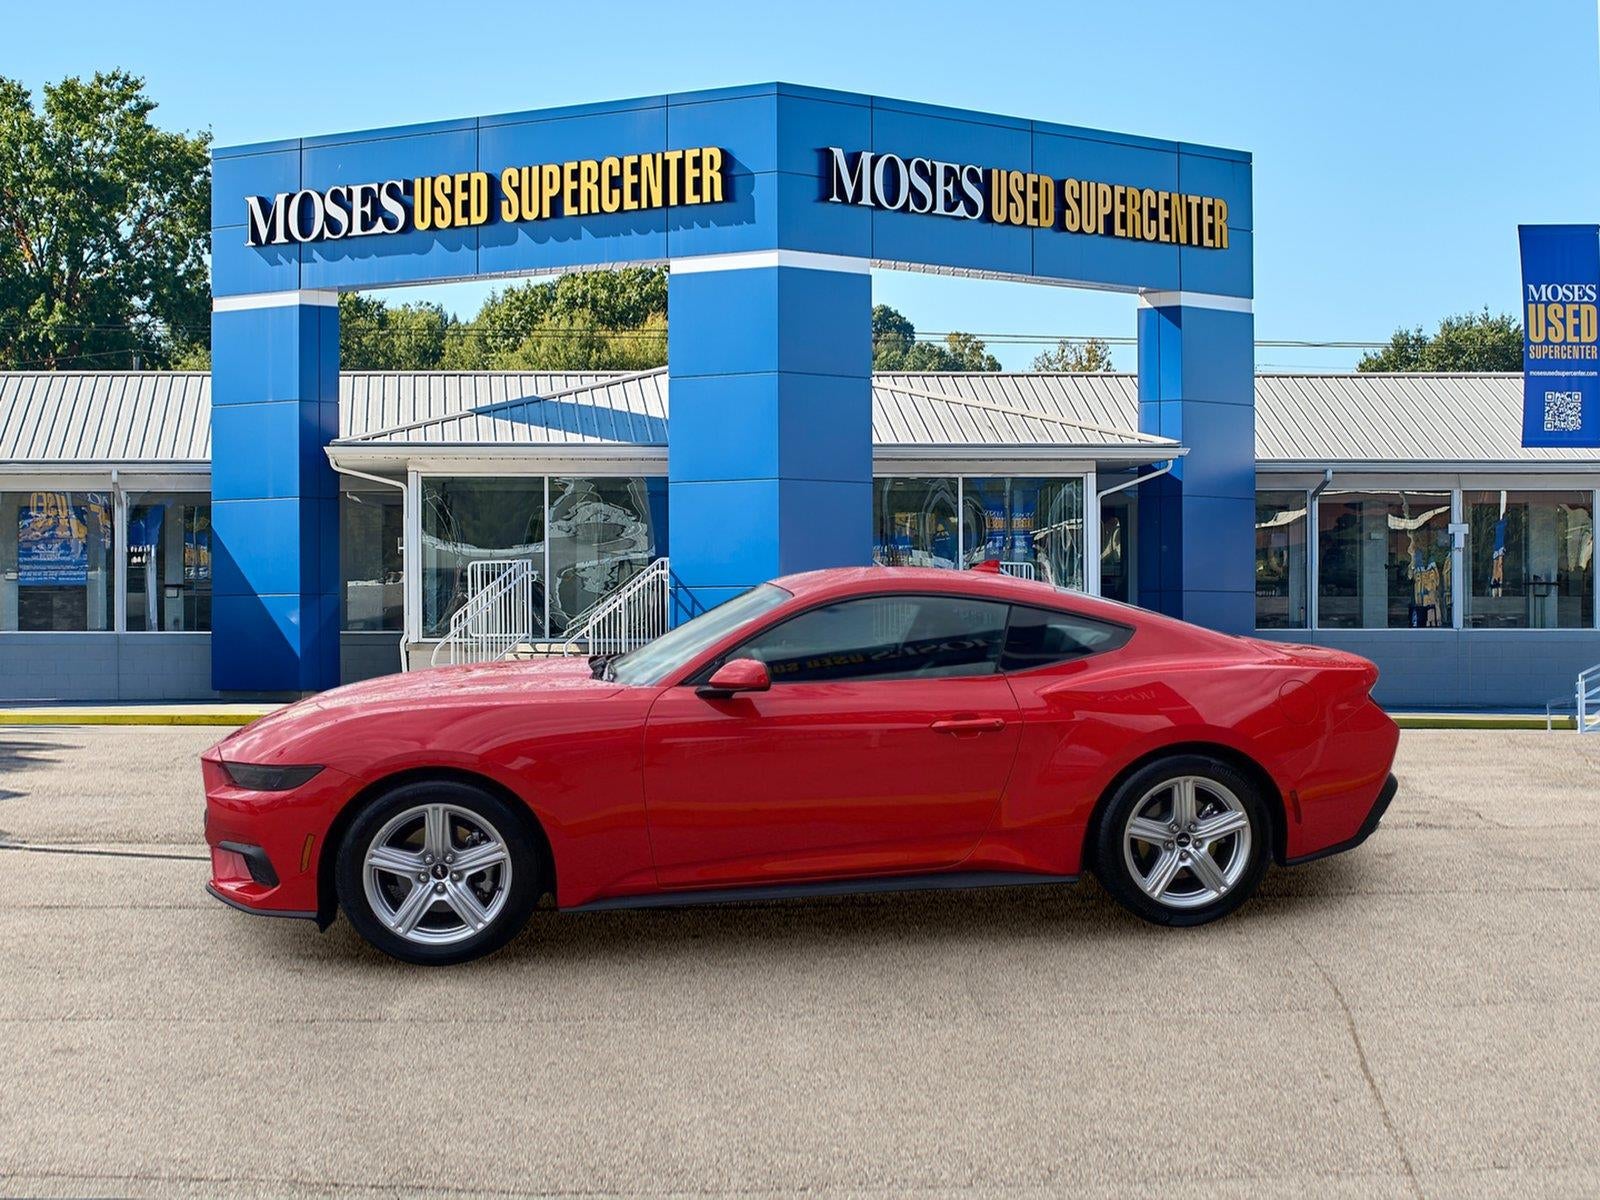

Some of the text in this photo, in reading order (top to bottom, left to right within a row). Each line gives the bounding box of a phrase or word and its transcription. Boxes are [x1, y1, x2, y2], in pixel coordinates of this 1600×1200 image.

[245, 146, 725, 248] MOSES USED SUPERCENTER
[828, 146, 1230, 250] MOSES USED SUPERCENTER
[1527, 283, 1598, 302] MOSES
[1528, 303, 1599, 344] USED
[1529, 344, 1599, 360] SUPERCENTER
[1529, 369, 1599, 378] mosesusedsupercenter.com
